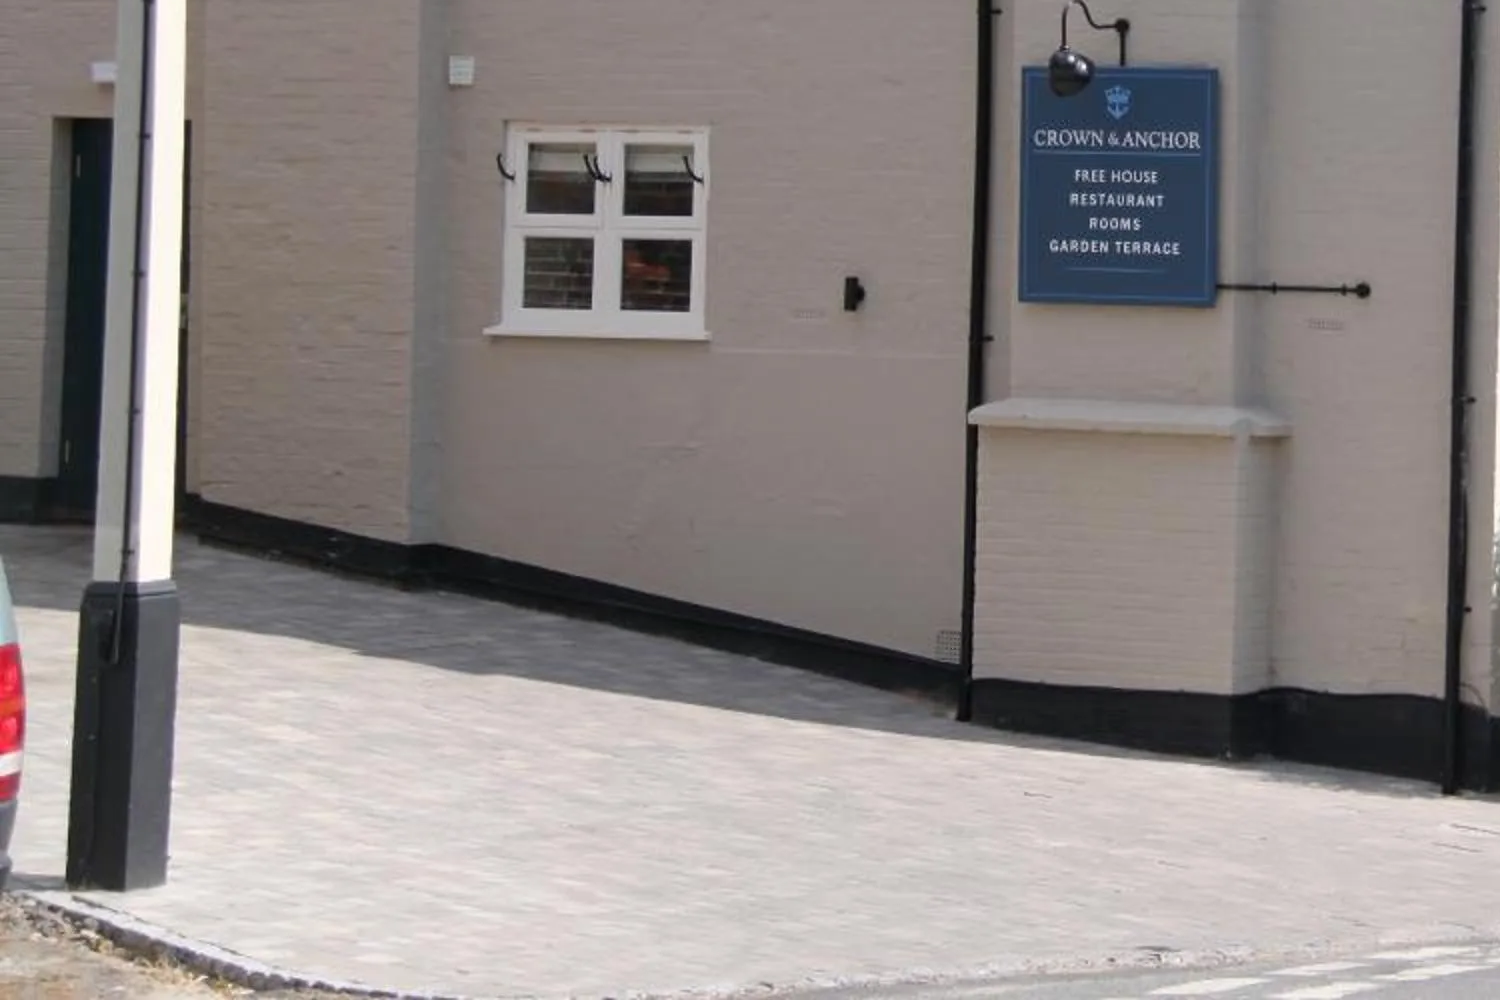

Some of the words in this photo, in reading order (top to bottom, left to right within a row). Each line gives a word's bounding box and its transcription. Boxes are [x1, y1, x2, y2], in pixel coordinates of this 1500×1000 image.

[1034, 129, 1104, 147] CROWN
[1107, 132, 1120, 146] &
[1122, 131, 1201, 150] ANCHOR
[1074, 169, 1107, 184] FREE
[1111, 169, 1159, 185] HOUSE
[1069, 192, 1165, 208] RESTAURANT
[1089, 217, 1142, 231] ROOMS
[1049, 239, 1109, 254] GARDEN
[1115, 241, 1181, 256] TERRACE
